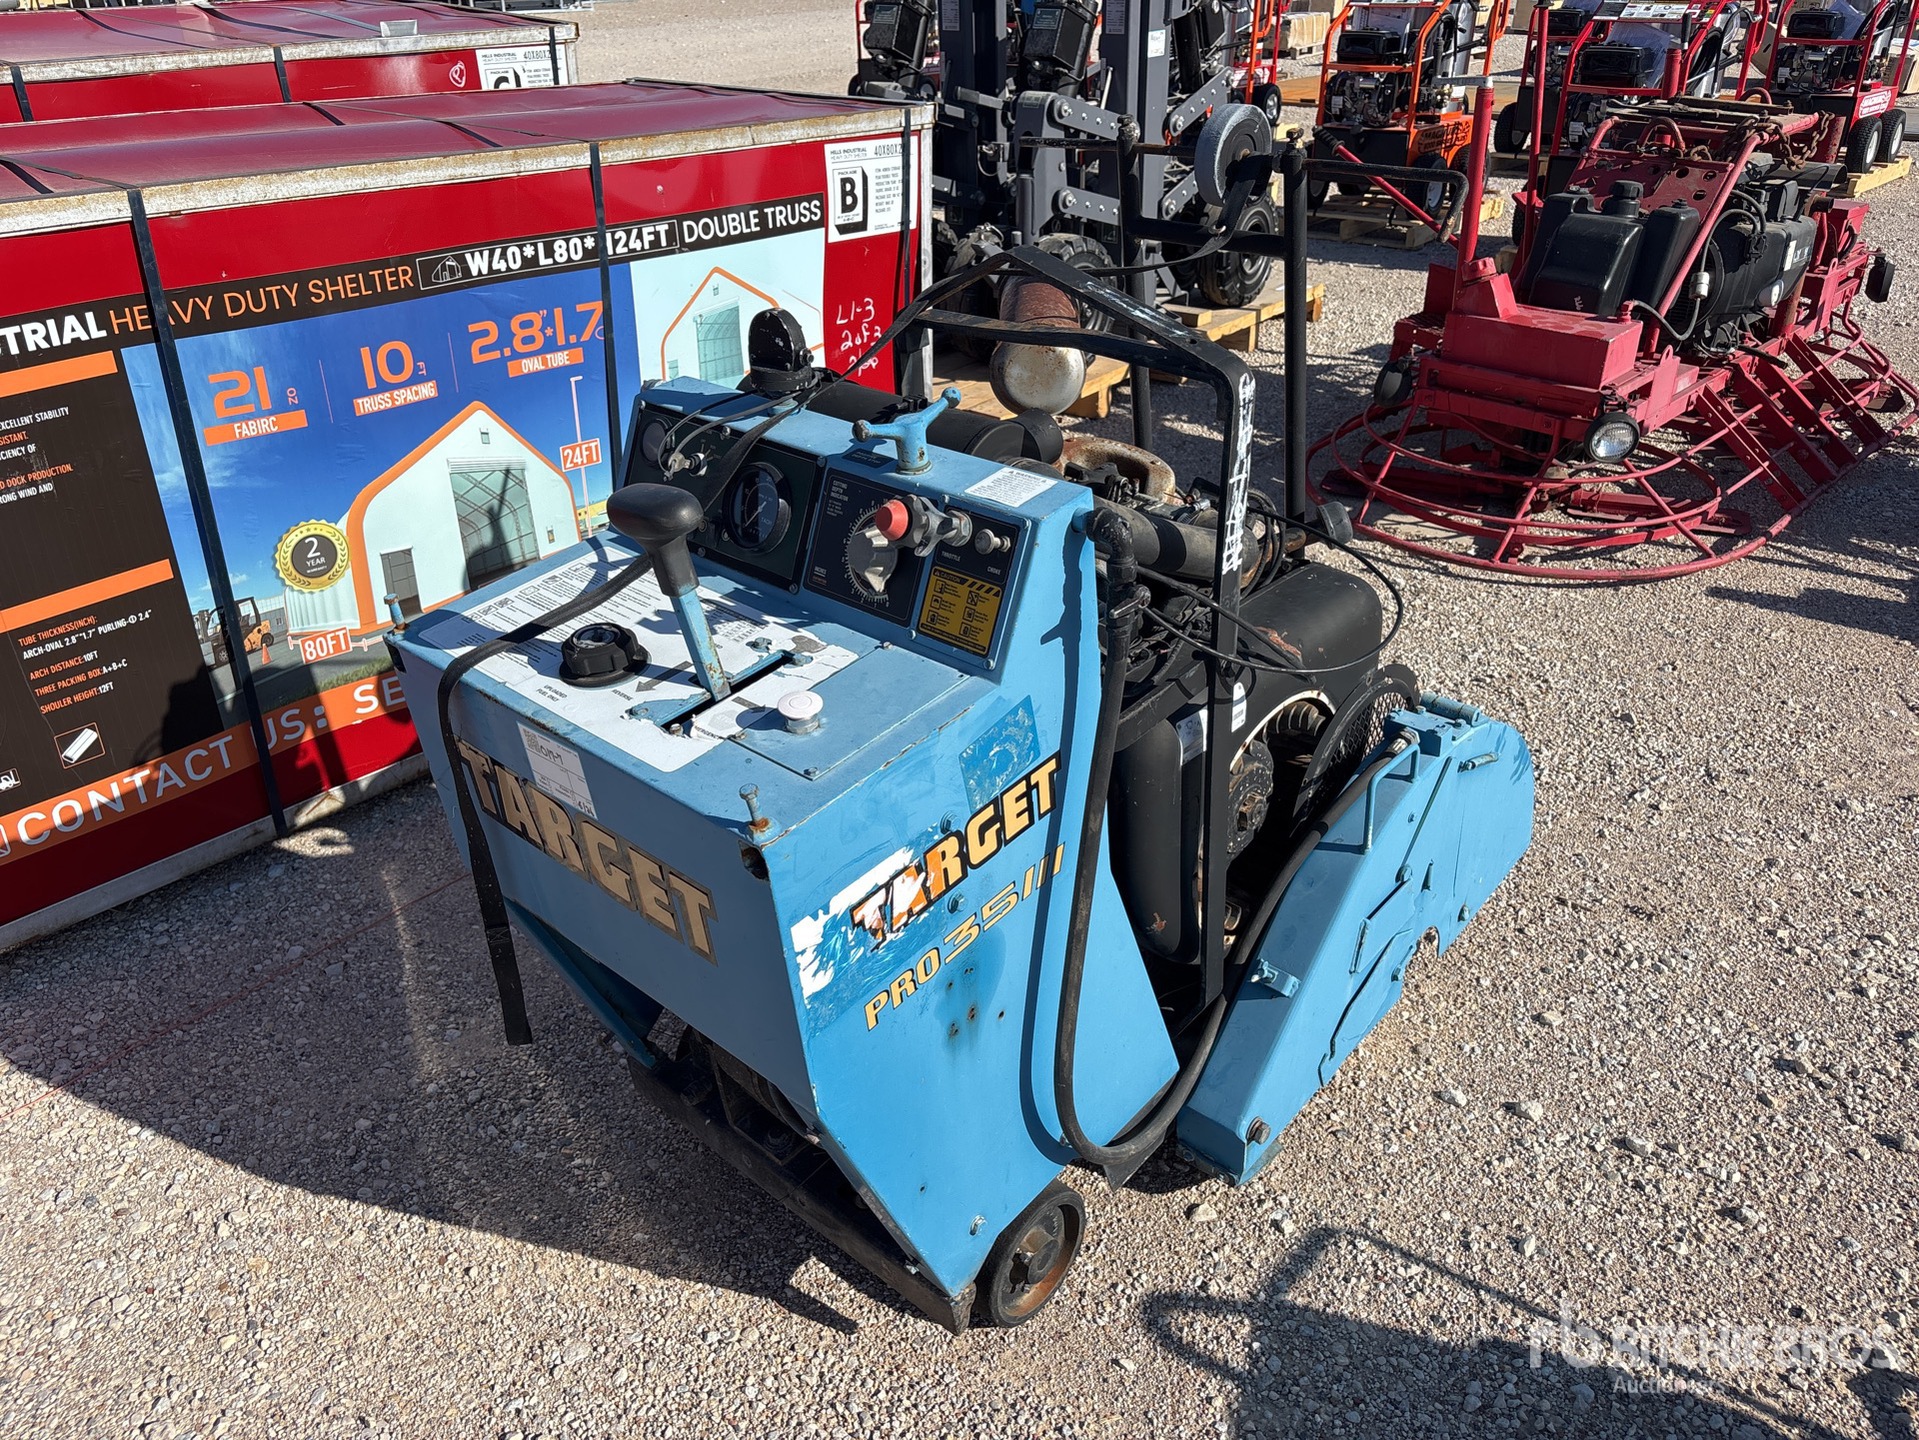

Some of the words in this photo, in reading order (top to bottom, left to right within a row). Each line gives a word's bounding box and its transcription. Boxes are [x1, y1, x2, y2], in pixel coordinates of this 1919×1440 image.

[523, 49, 552, 60] 40X80X2
[874, 143, 903, 156] 40X80X2
[840, 177, 858, 214] B
[682, 210, 760, 243] DOUBLE
[764, 200, 821, 229] TRUSS
[0, 311, 107, 355] TRIAL
[223, 282, 299, 318] DUTY
[308, 265, 415, 304] SHELTER
[360, 340, 414, 389] 10
[521, 358, 545, 373] OVAL
[546, 351, 570, 368] TUBE
[208, 366, 272, 419] 21
[357, 393, 392, 414] TRUSS
[393, 382, 436, 405] SPACING
[34, 406, 69, 423] STABILITY
[233, 416, 279, 439] FABIRC
[0, 446, 26, 461] CIENCY
[27, 443, 37, 453] OF
[563, 441, 598, 469] 24FT
[6, 475, 27, 488] DOCK
[27, 463, 74, 482] PRODUCTION.
[17, 486, 38, 499] WIND
[38, 482, 53, 494] AND
[304, 537, 321, 558] 2
[941, 550, 960, 561] THROTTLE
[306, 557, 326, 567] YEAR
[987, 566, 1001, 575] CHOKE
[18, 635, 37, 647] TUBE
[23, 640, 64, 660] ARCH-OVAL
[304, 630, 347, 661] 80FT
[29, 667, 49, 681] ARCH
[34, 684, 57, 697] THREE
[57, 672, 87, 690] PACKING
[40, 697, 73, 715] SHOULER
[16, 734, 233, 846] CONTACT
[250, 705, 328, 751] US:
[455, 736, 718, 967] TARGET
[850, 752, 1061, 952] TARGET
